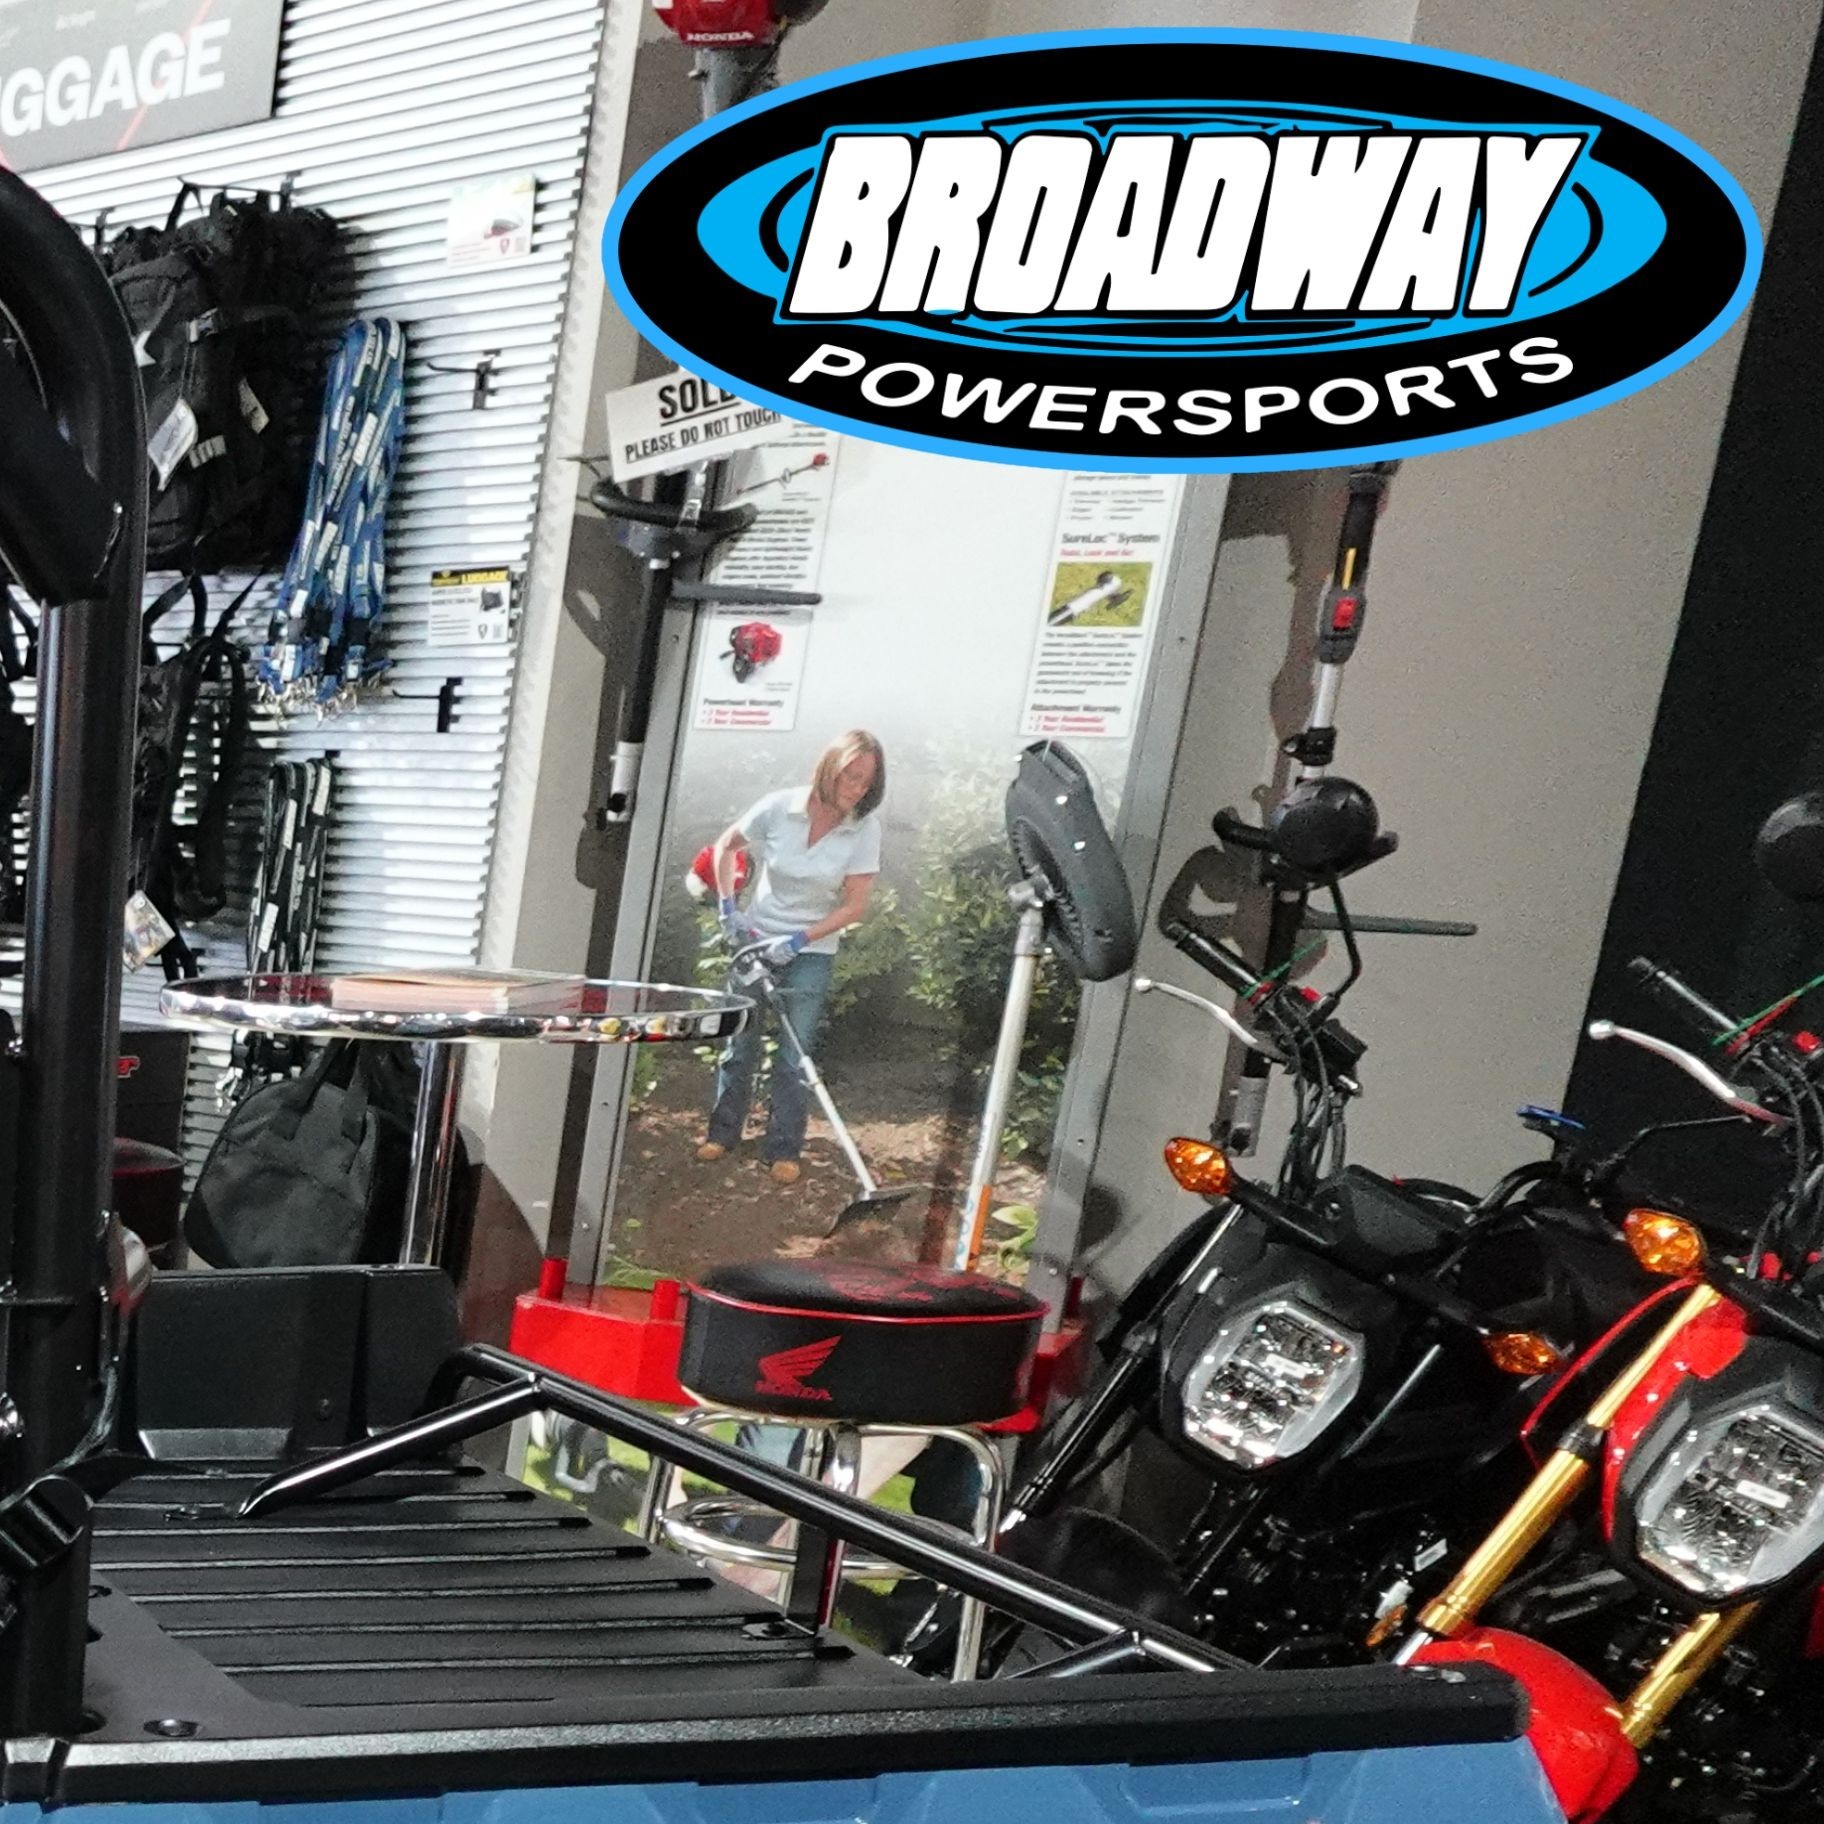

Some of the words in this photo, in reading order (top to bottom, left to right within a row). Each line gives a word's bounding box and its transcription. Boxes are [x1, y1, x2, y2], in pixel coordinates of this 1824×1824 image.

[687, 31, 754, 41] HONDA
[625, 432, 677, 464] PLEASE
[681, 426, 699, 447] DO
[704, 416, 731, 441] NOT
